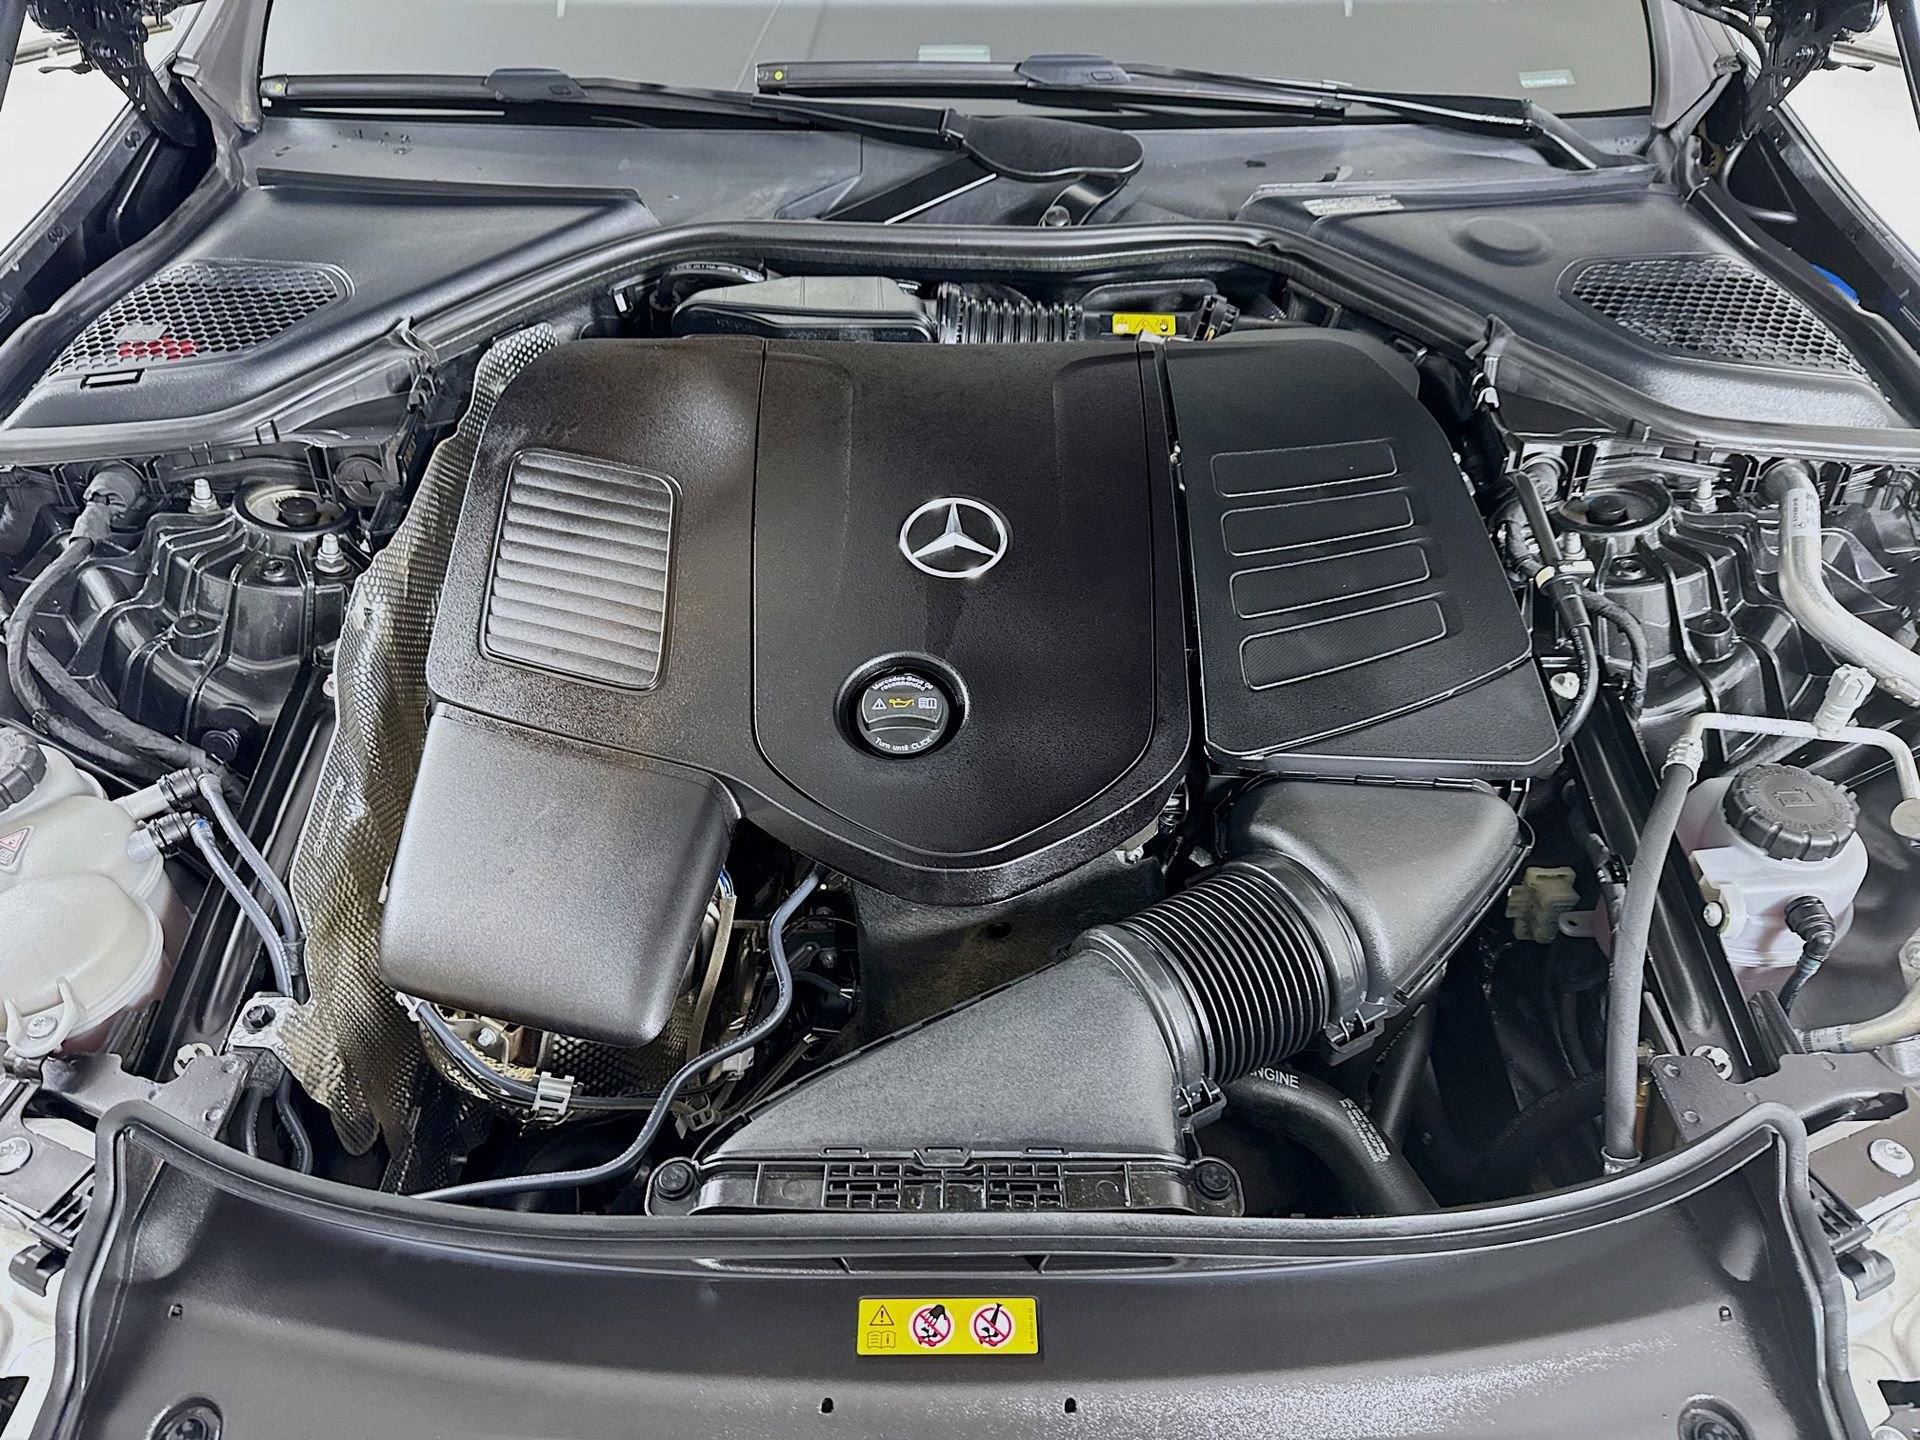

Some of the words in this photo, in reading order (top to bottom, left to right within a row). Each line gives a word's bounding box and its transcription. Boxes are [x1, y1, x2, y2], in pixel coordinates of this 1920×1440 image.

[871, 676, 924, 690] Mercedes-Benz
[880, 680, 926, 692] recommended
[875, 736, 891, 749] Turn
[911, 736, 932, 750] CLICK
[1250, 1067, 1300, 1089] NGINE
